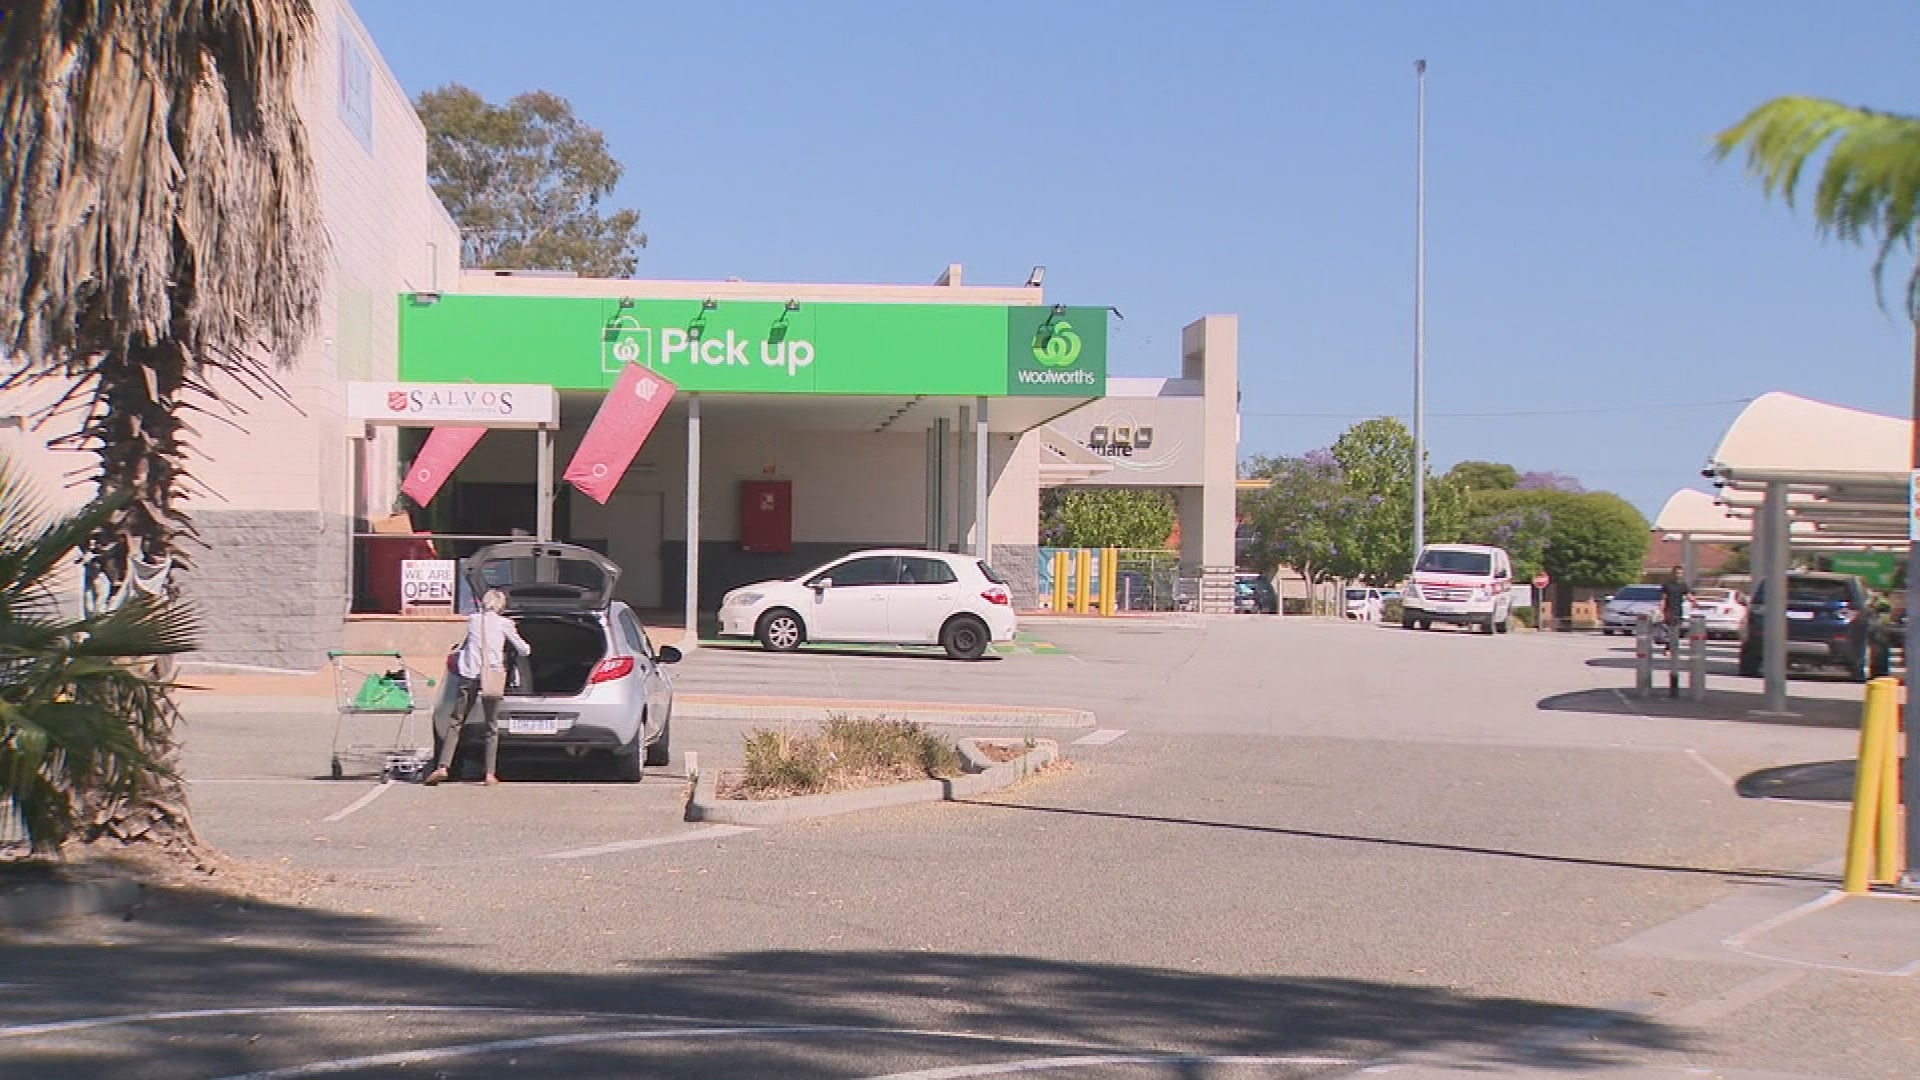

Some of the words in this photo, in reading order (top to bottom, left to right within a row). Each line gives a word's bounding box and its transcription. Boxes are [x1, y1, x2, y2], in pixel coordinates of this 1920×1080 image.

[661, 327, 750, 366] Pick
[760, 340, 815, 377] up
[410, 389, 513, 415] SALVOS
[1080, 441, 1133, 457] uare
[404, 569, 424, 581] WE
[427, 569, 453, 581] ARE
[403, 581, 453, 599] OPEN
